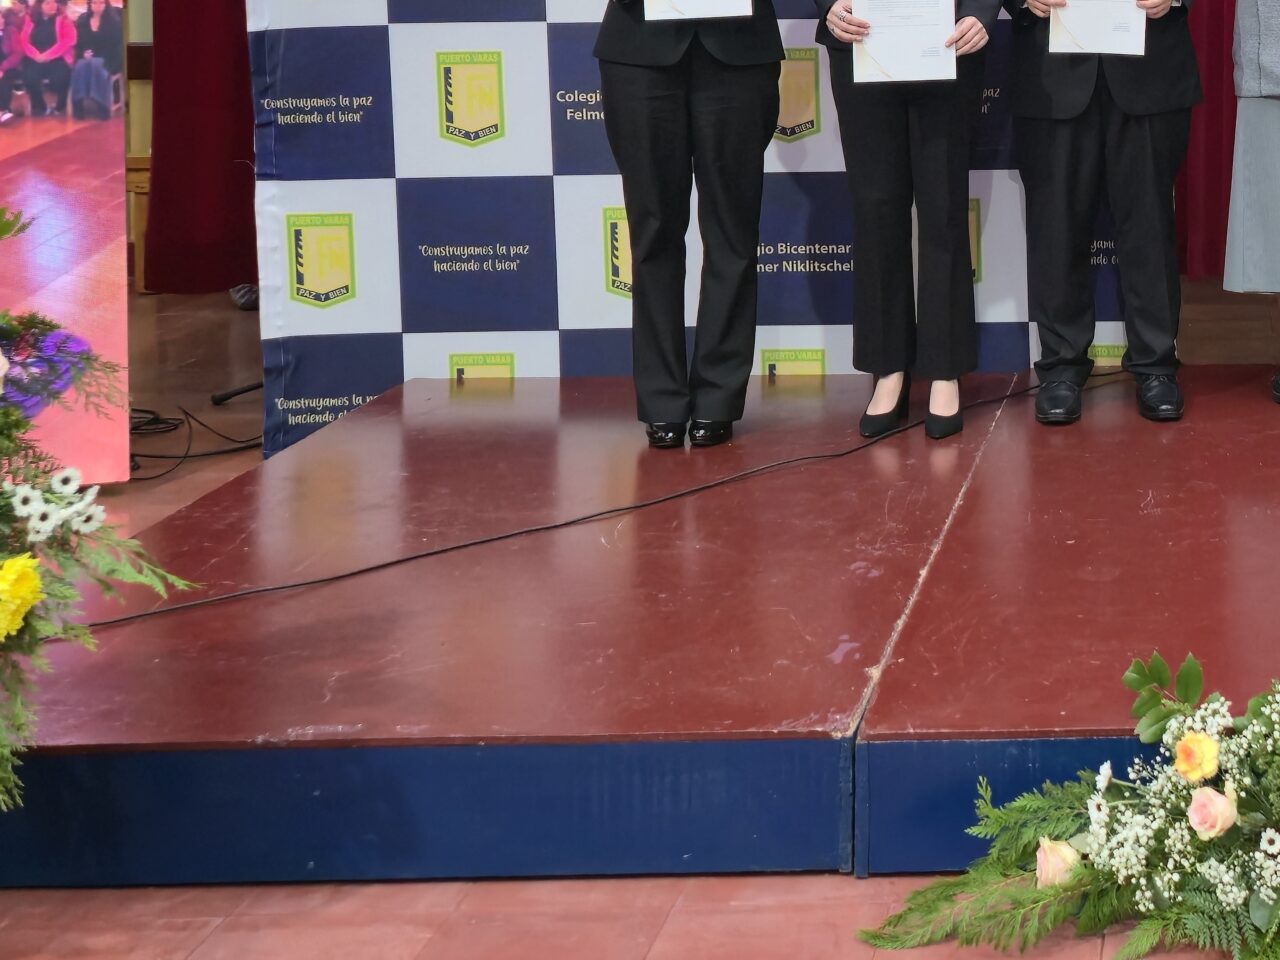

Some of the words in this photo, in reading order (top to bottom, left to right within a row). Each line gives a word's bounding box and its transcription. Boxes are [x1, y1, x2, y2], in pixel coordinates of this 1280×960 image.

[556, 90, 602, 104] Colegi
[982, 88, 1000, 99] paz
[339, 94, 350, 108] la
[353, 96, 373, 108] paz
[277, 112, 323, 125] haciendo
[326, 112, 335, 123] el
[566, 109, 605, 120] Felm
[449, 127, 465, 137] PAZ
[478, 126, 497, 136] BIEN
[496, 244, 506, 256] la
[510, 246, 529, 257] paz
[777, 243, 852, 254] Bicentenar
[433, 260, 480, 273] haciendo
[483, 260, 492, 271] el
[288, 413, 335, 426] haciendo
